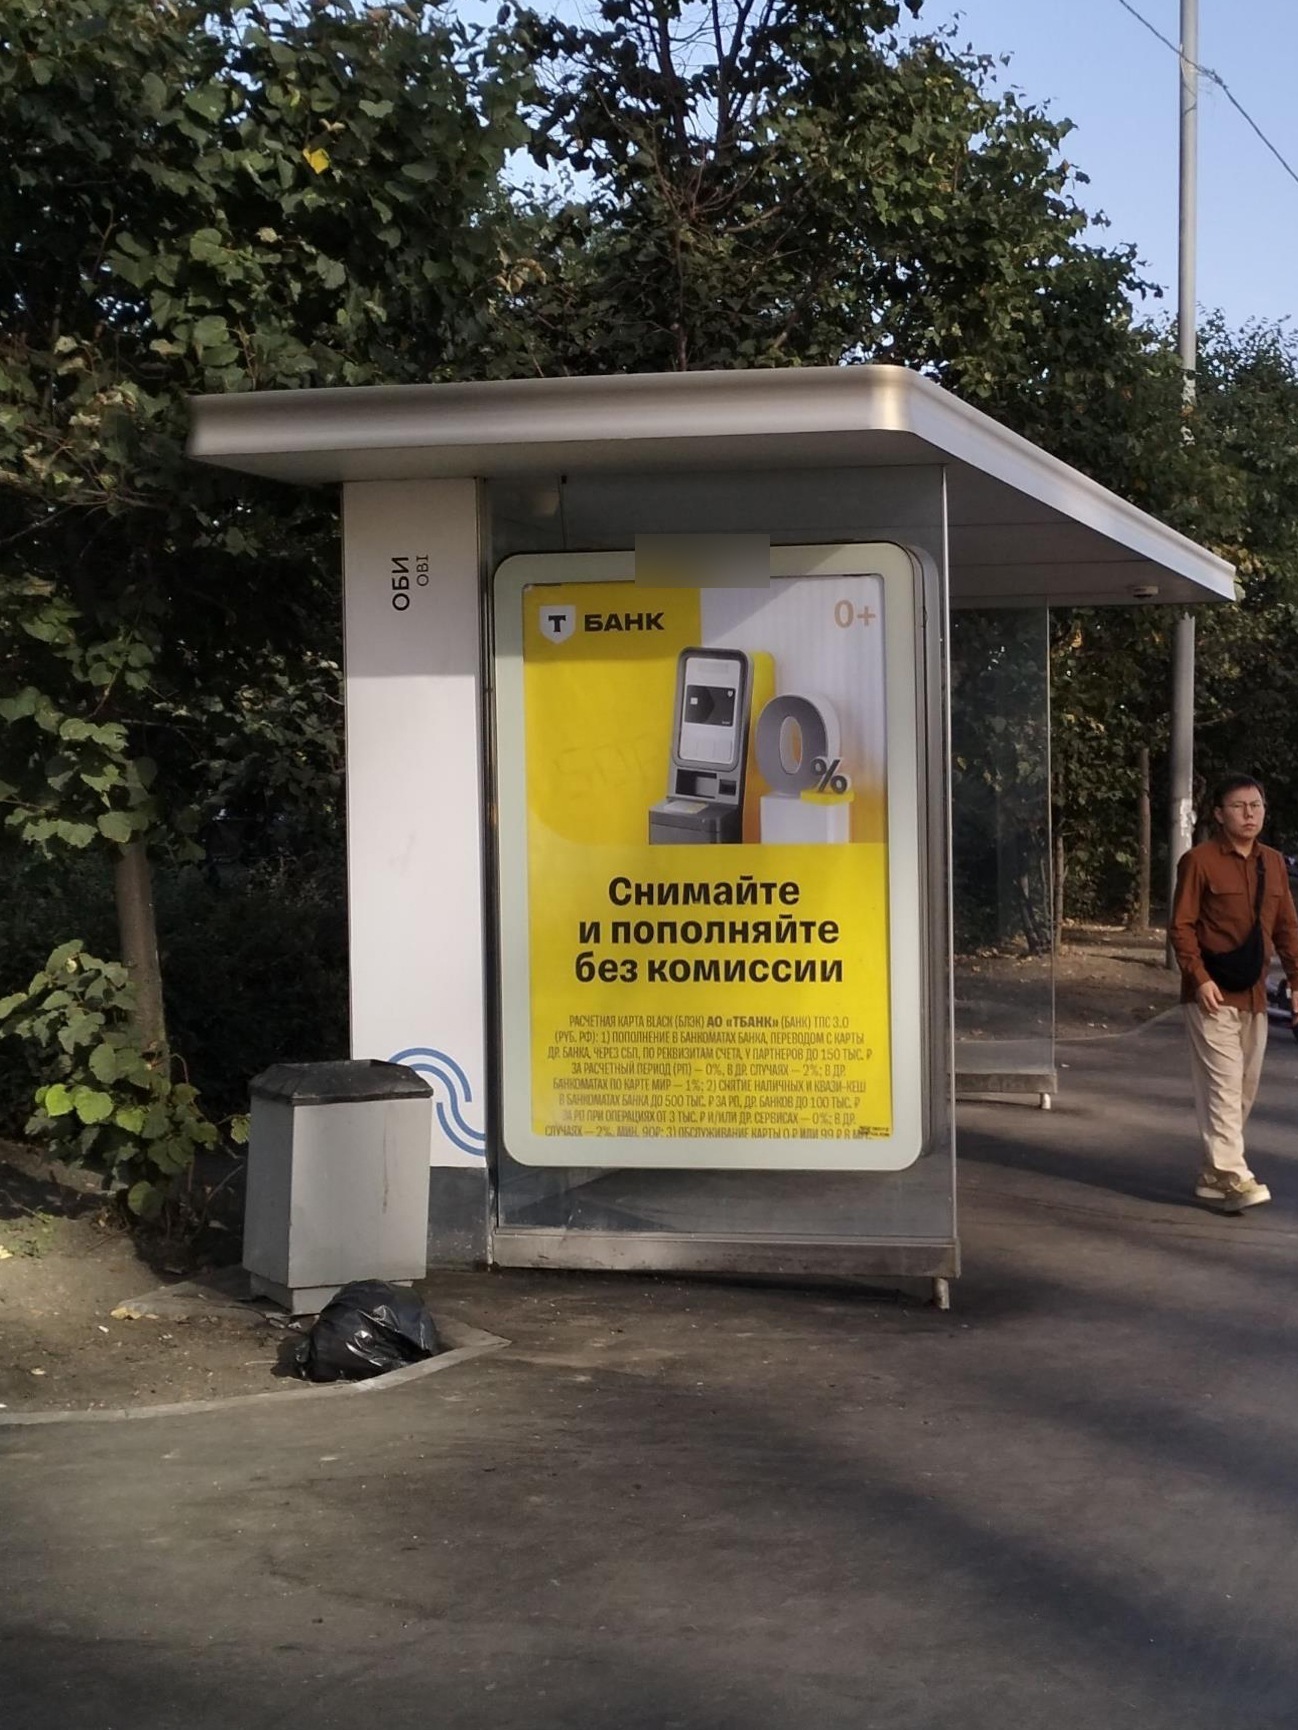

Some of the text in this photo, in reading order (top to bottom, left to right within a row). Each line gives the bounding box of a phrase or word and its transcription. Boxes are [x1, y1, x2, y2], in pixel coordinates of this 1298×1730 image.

[392, 557, 410, 611] ОБИ
[416, 554, 429, 587] OBI
[584, 612, 665, 632] БАНК
[834, 599, 876, 629] 0+
[609, 875, 800, 906] Снимайте
[579, 914, 840, 944] и пополняйте
[575, 950, 843, 983] без комиссии
[706, 1016, 723, 1029] АО
[726, 1016, 779, 1029] «ТБАНК»
[821, 1048, 840, 1060] 150
